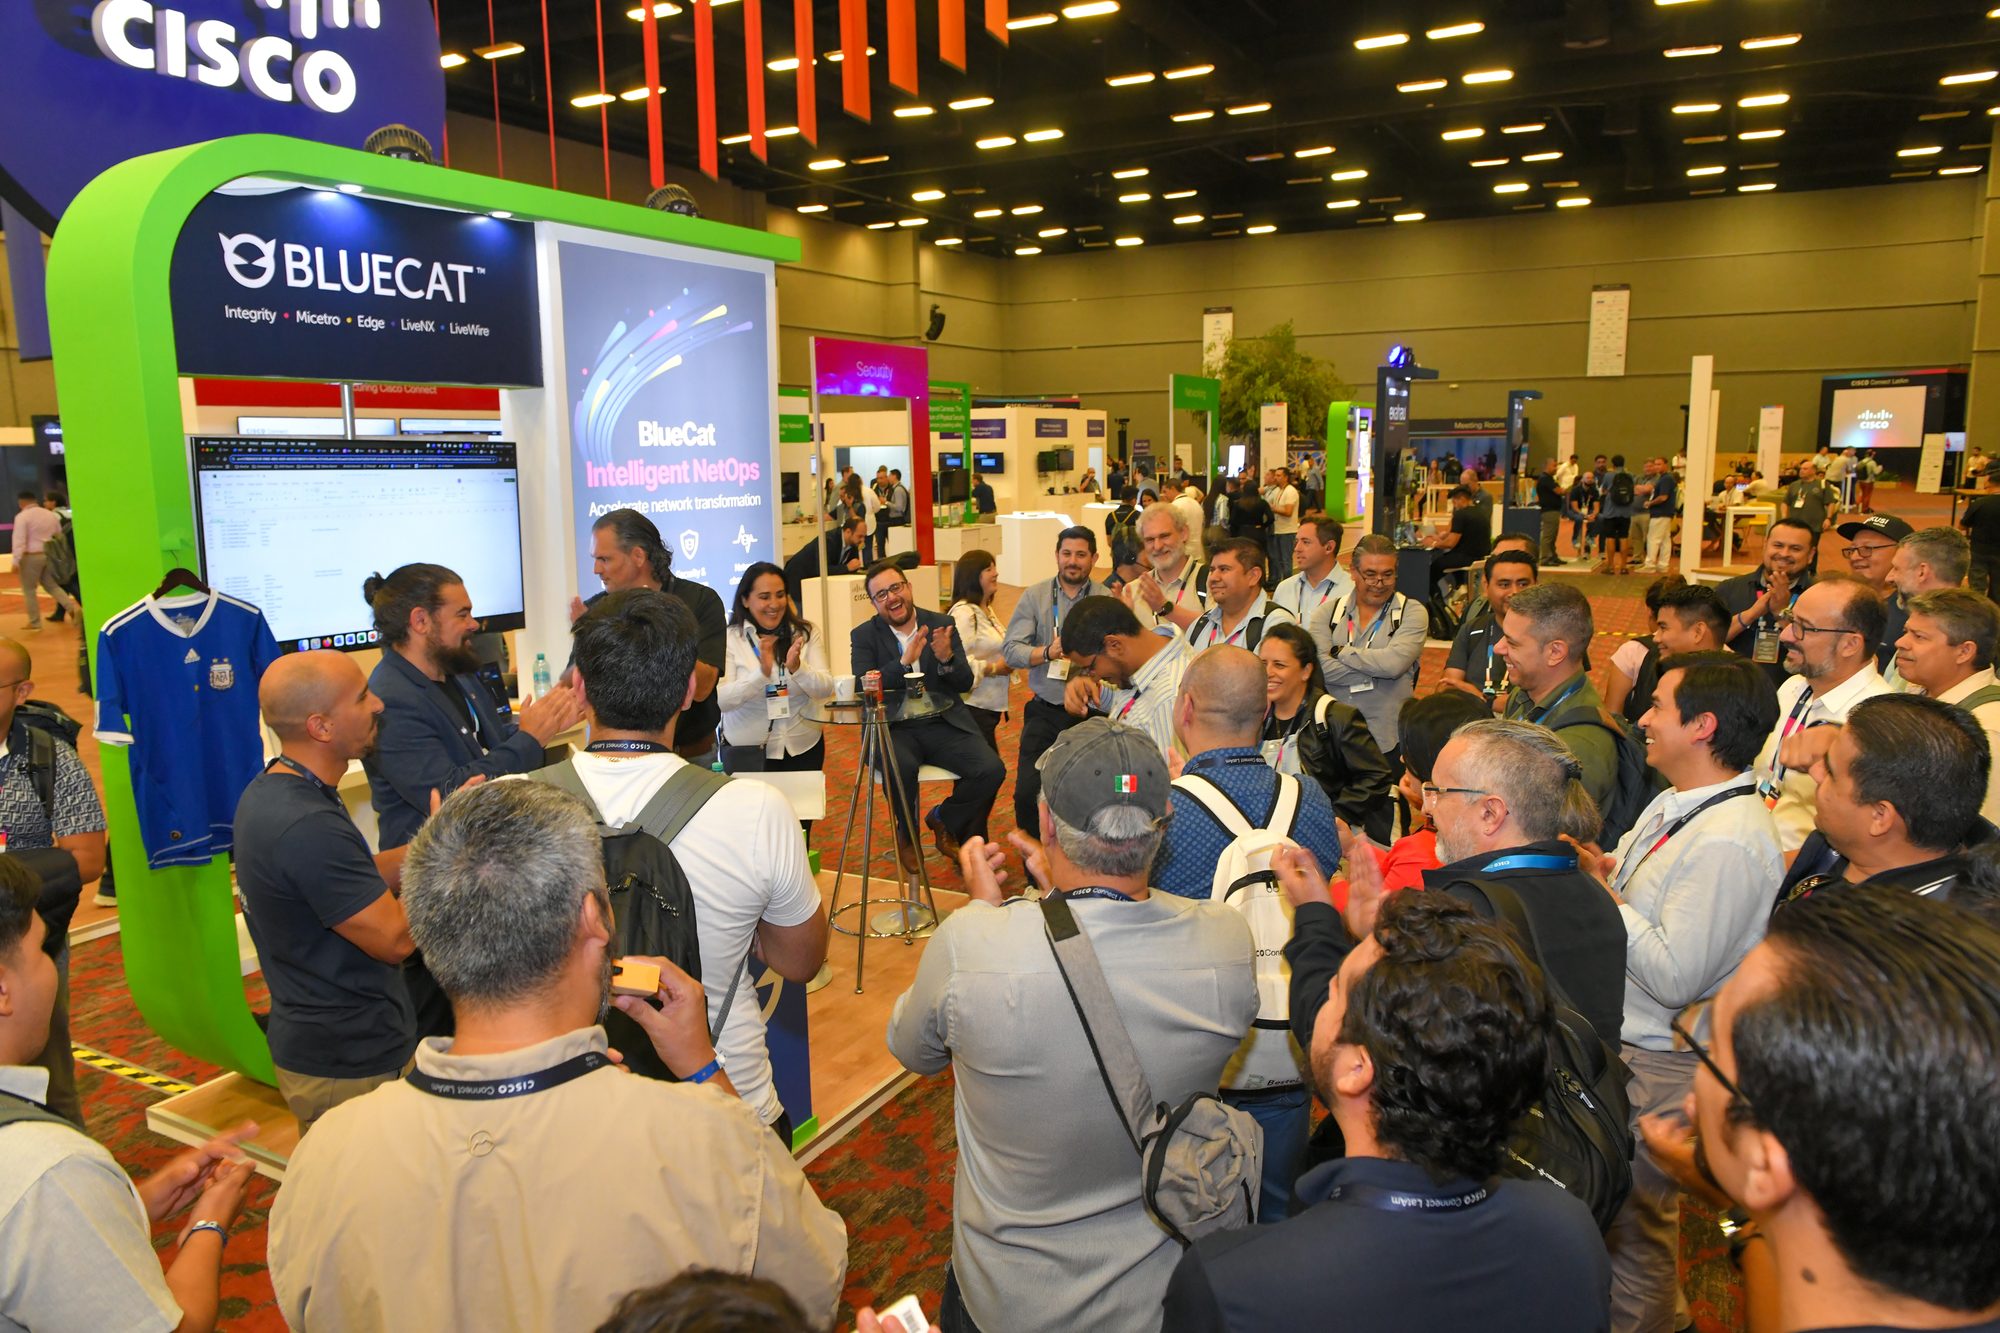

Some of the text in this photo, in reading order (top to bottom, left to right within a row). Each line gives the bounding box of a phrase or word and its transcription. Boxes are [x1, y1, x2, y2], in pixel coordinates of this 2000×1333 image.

[94, 0, 357, 114] CISCO
[224, 305, 490, 338] Integrity Micetro Edge LiveNX LiveWire
[855, 361, 895, 382] Security
[379, 384, 403, 393] Cisco
[403, 385, 438, 394] Connect
[1870, 378, 1891, 386] Connect
[638, 420, 717, 448] BlueCat
[1454, 421, 1505, 430] Meeting Room
[1859, 420, 1890, 430] CISCO
[586, 457, 761, 492] Intelligent NetOps
[588, 494, 762, 518] Accelerate network transformation
[1072, 887, 1092, 897] CISCO
[1092, 887, 1118, 900] Connect
[430, 1079, 536, 1096] CISCO Connect LatAm
[1390, 1188, 1488, 1208] CISCO Connect LatAm
